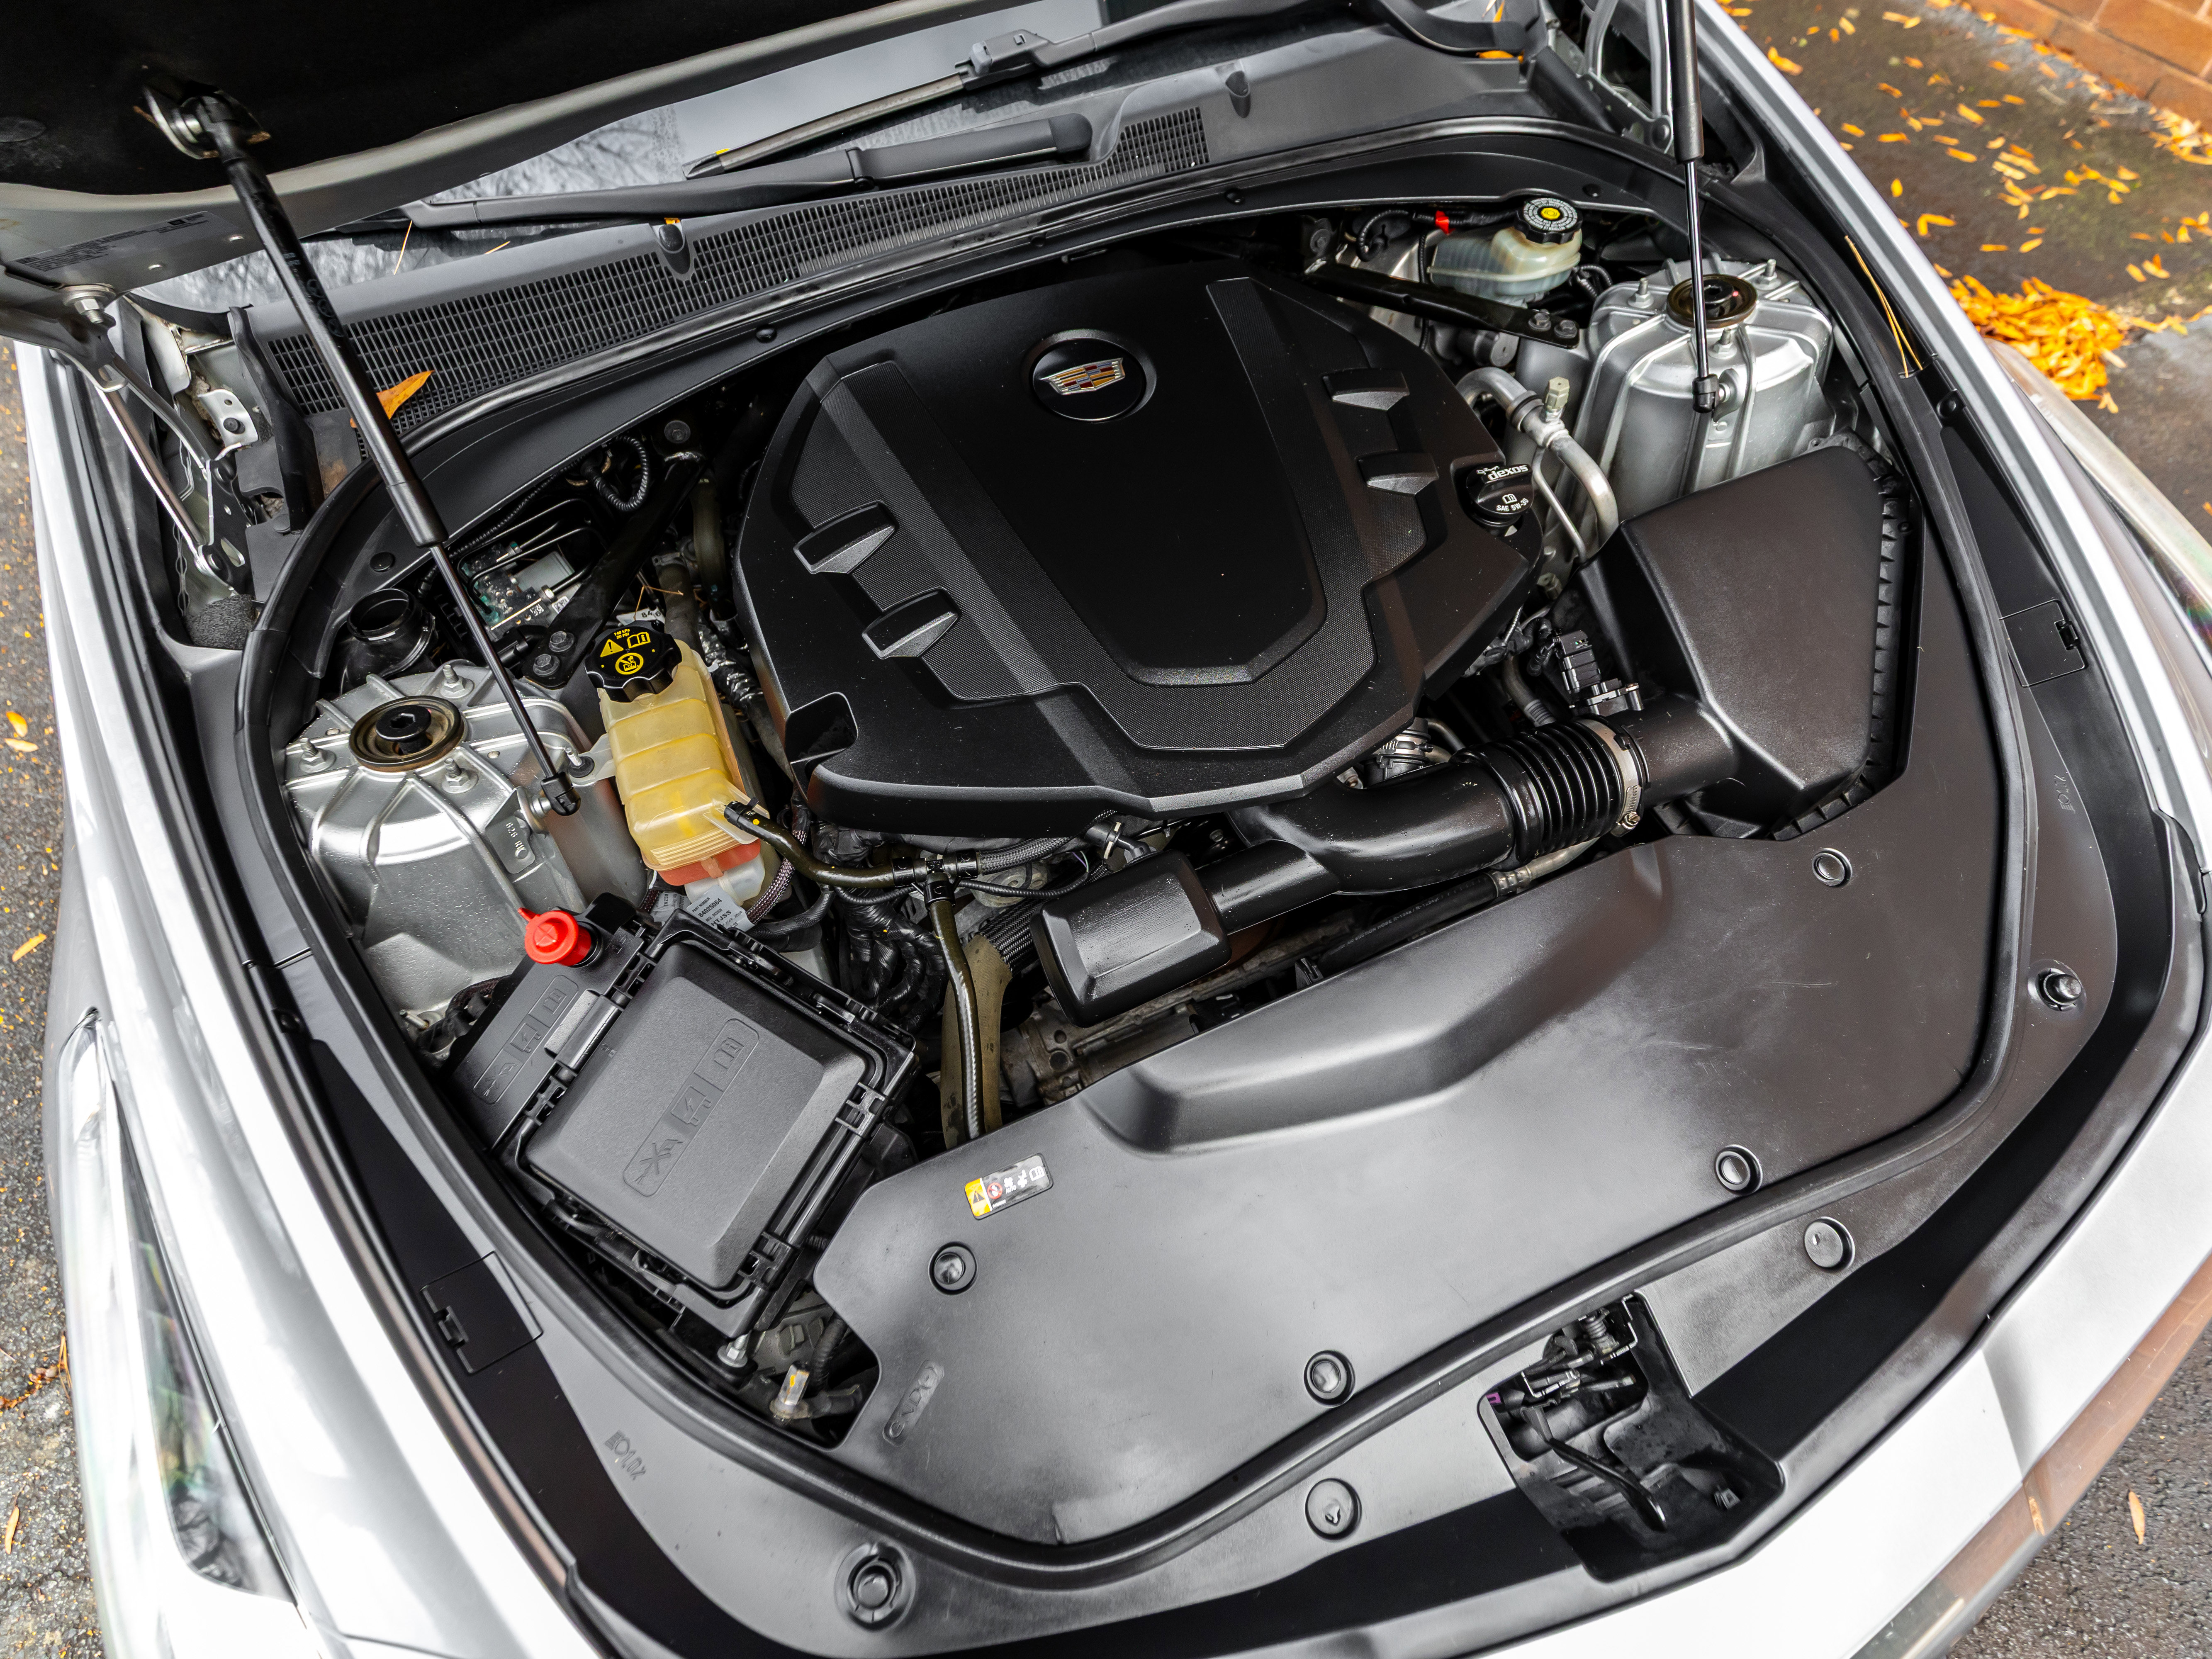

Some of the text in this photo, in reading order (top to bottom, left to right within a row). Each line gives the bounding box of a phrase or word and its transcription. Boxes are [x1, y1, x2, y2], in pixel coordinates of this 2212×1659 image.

[1487, 465, 1528, 480] dexos
[1511, 498, 1529, 511] 5W-30
[698, 898, 722, 917] 84025064
[699, 897, 711, 907] NUMBER
[711, 910, 731, 926] HTJSS
[712, 908, 723, 917] DESIGN
[1005, 1185, 1017, 1194] AUTO
